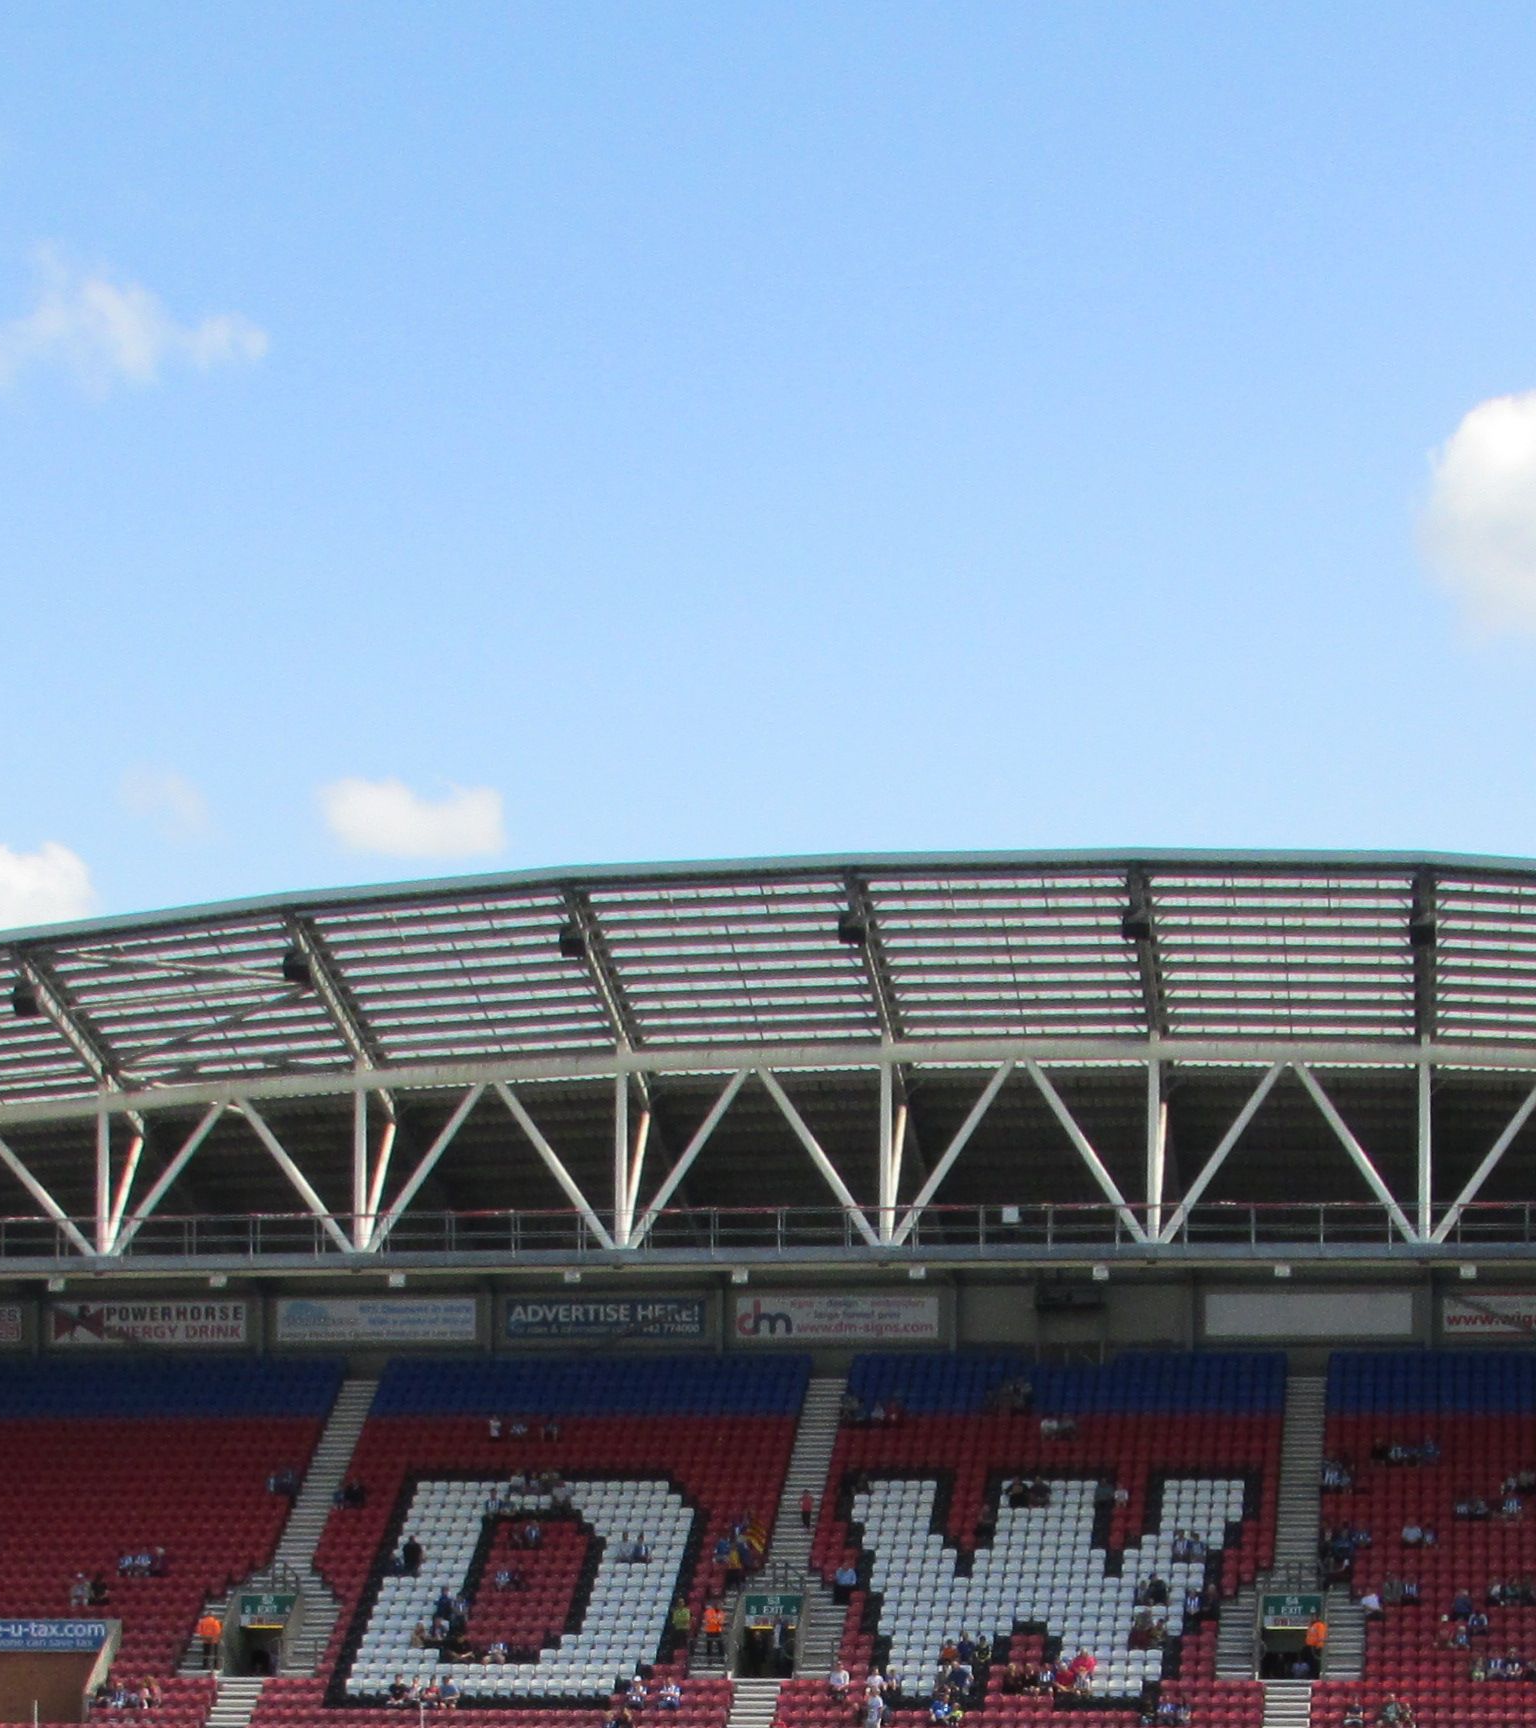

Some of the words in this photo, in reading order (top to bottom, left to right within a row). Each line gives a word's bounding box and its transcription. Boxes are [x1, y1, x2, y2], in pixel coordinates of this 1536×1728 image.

[510, 1304, 631, 1322] ADVERTISE
[736, 1299, 792, 1336] dm
[185, 1325, 241, 1339] DRINK
[797, 1321, 933, 1336] www.dm-signs.com
[256, 1605, 277, 1614] EXIT
[763, 1605, 784, 1614] EXIT
[1281, 1606, 1303, 1615] EXIT
[26, 1639, 47, 1647] can
[49, 1639, 75, 1647] save
[76, 1638, 93, 1647] tax
